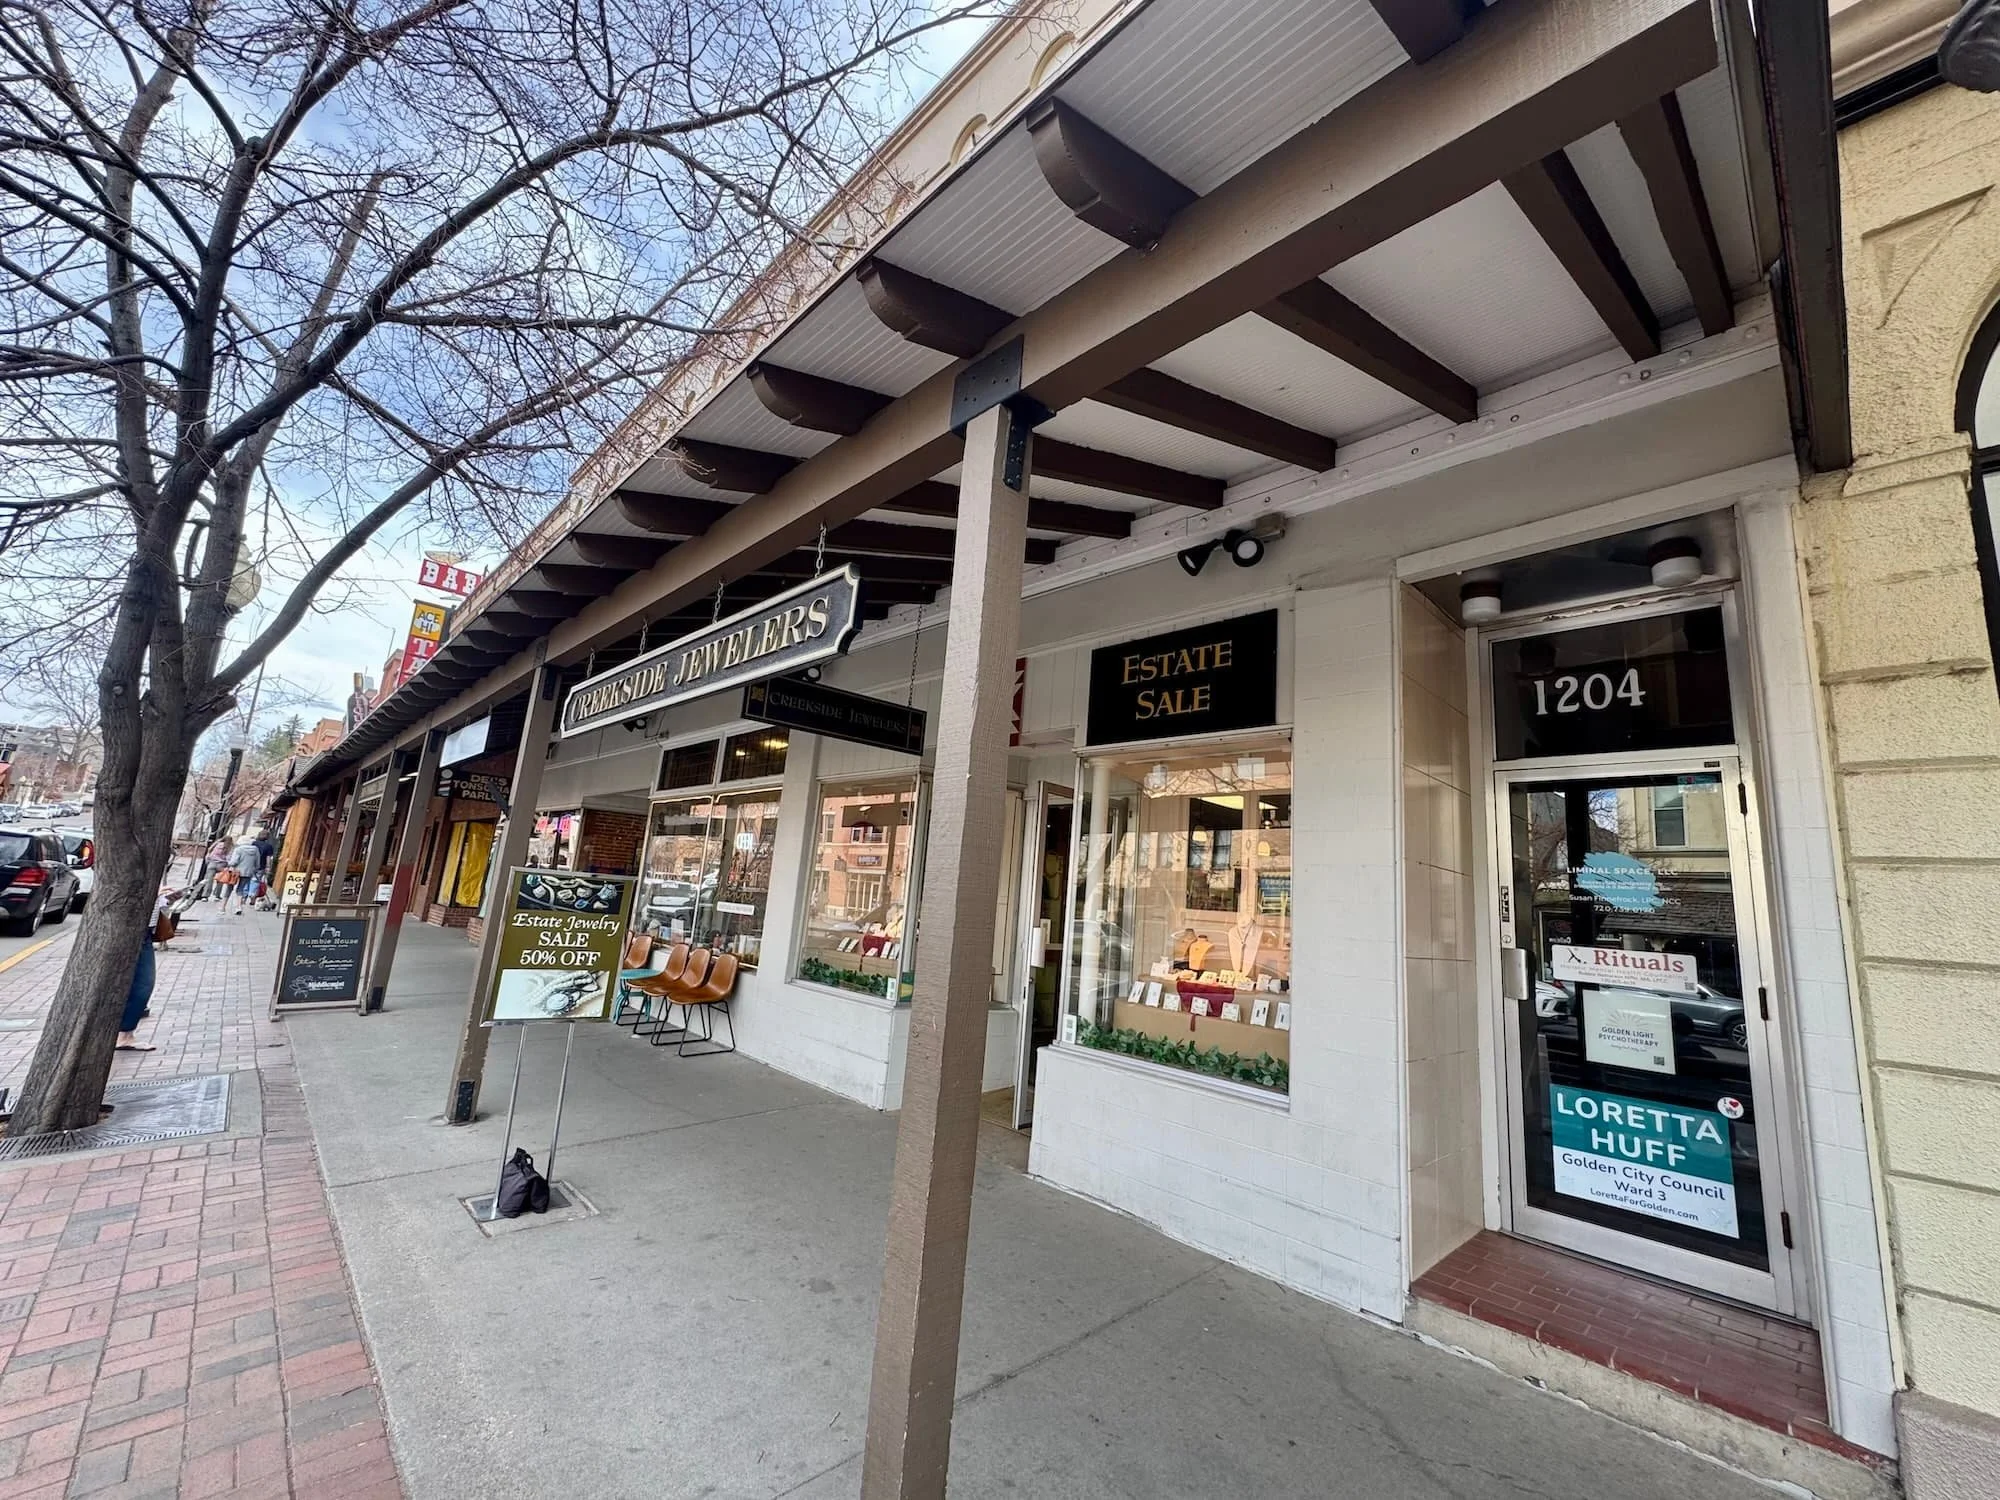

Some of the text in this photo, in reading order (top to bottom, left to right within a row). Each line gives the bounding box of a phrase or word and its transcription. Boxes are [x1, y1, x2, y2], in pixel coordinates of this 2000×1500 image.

[417, 610, 441, 624] ACE
[420, 621, 433, 634] HI
[570, 596, 830, 722] CREEKSIDE JEWELERS
[1121, 640, 1233, 685] ESTATE
[769, 690, 844, 719] CREEKSIDE
[1136, 684, 1211, 721] SALE
[1533, 668, 1646, 716] 1204
[512, 913, 620, 937] Estate Jewelry
[538, 930, 590, 948] SALE
[519, 949, 601, 967] 50% OFF
[1594, 950, 1685, 973] Rituals
[1598, 1033, 1660, 1048] PSYCHOTHERAPY
[1602, 1026, 1655, 1039] GOLDEN LIGHT
[1556, 1092, 1723, 1145] LORETTA
[1591, 1128, 1686, 1167] HUFF
[1562, 1153, 1726, 1201] Golden City Council
[1614, 1179, 1667, 1201] Ward 3
[1590, 1187, 1699, 1222] LorettaForGolden.com
